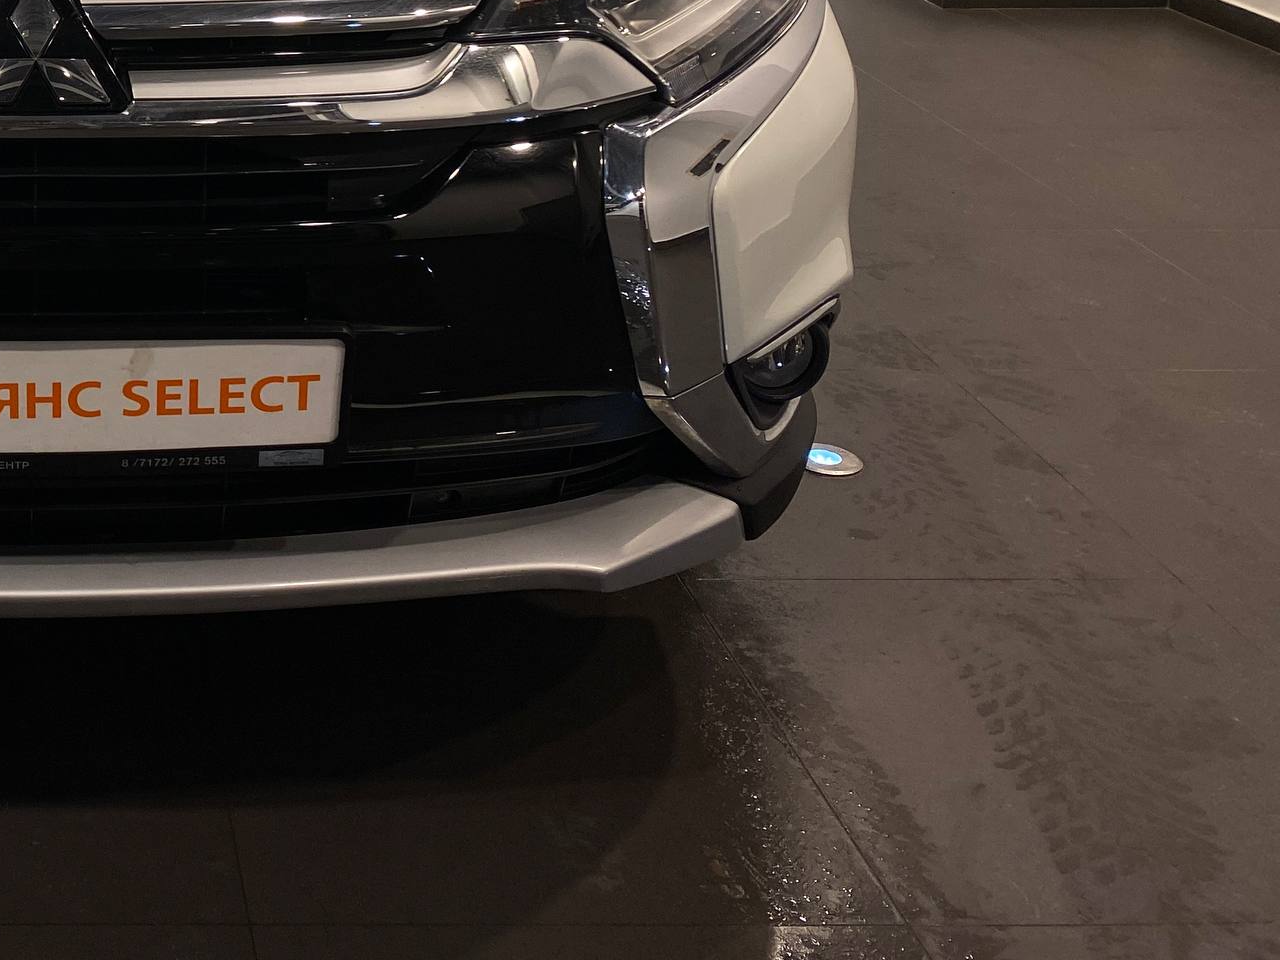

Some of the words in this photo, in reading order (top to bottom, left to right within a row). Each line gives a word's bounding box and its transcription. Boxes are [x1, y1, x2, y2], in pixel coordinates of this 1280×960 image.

[121, 374, 321, 416] SELECT
[178, 456, 200, 466] 272
[204, 455, 226, 465] 555
